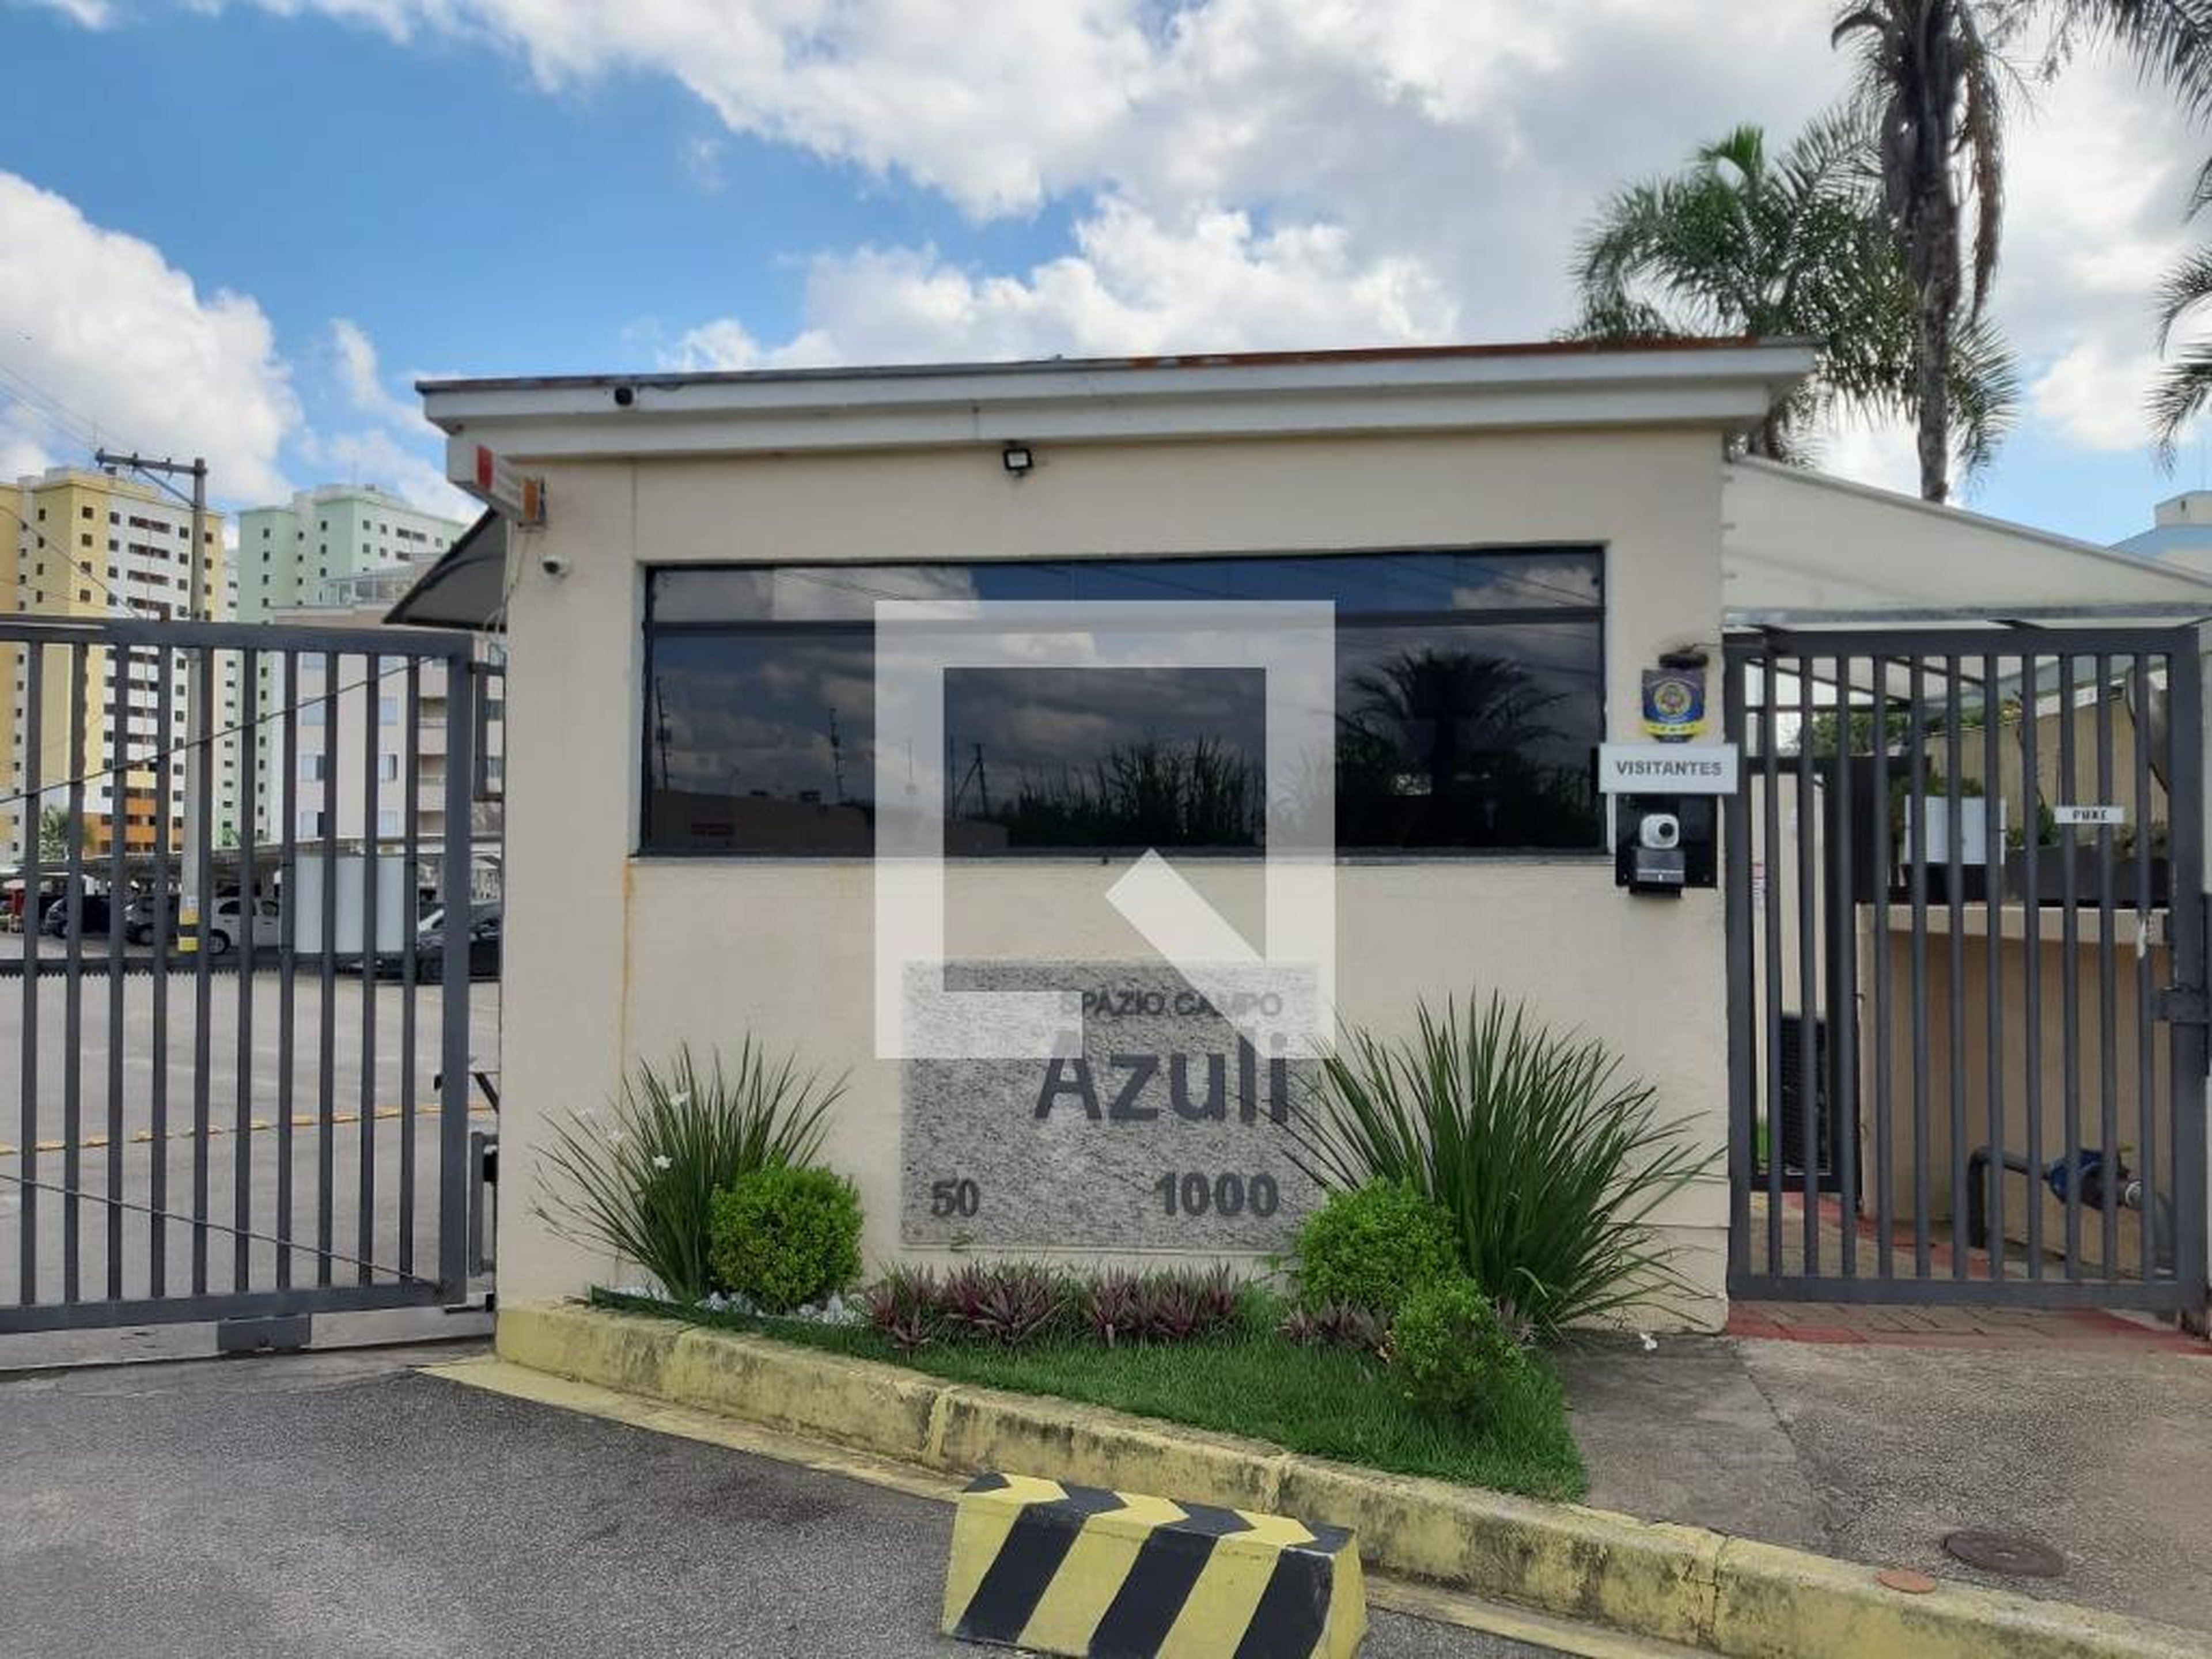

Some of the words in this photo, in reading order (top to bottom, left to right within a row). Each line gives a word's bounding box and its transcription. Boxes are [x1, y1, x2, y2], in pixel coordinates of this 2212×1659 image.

[1616, 760, 1722, 776] VISITANTES
[1035, 1027, 1289, 1122] Azuli
[930, 1177, 981, 1218] 50
[1156, 1172, 1279, 1217] 1000
